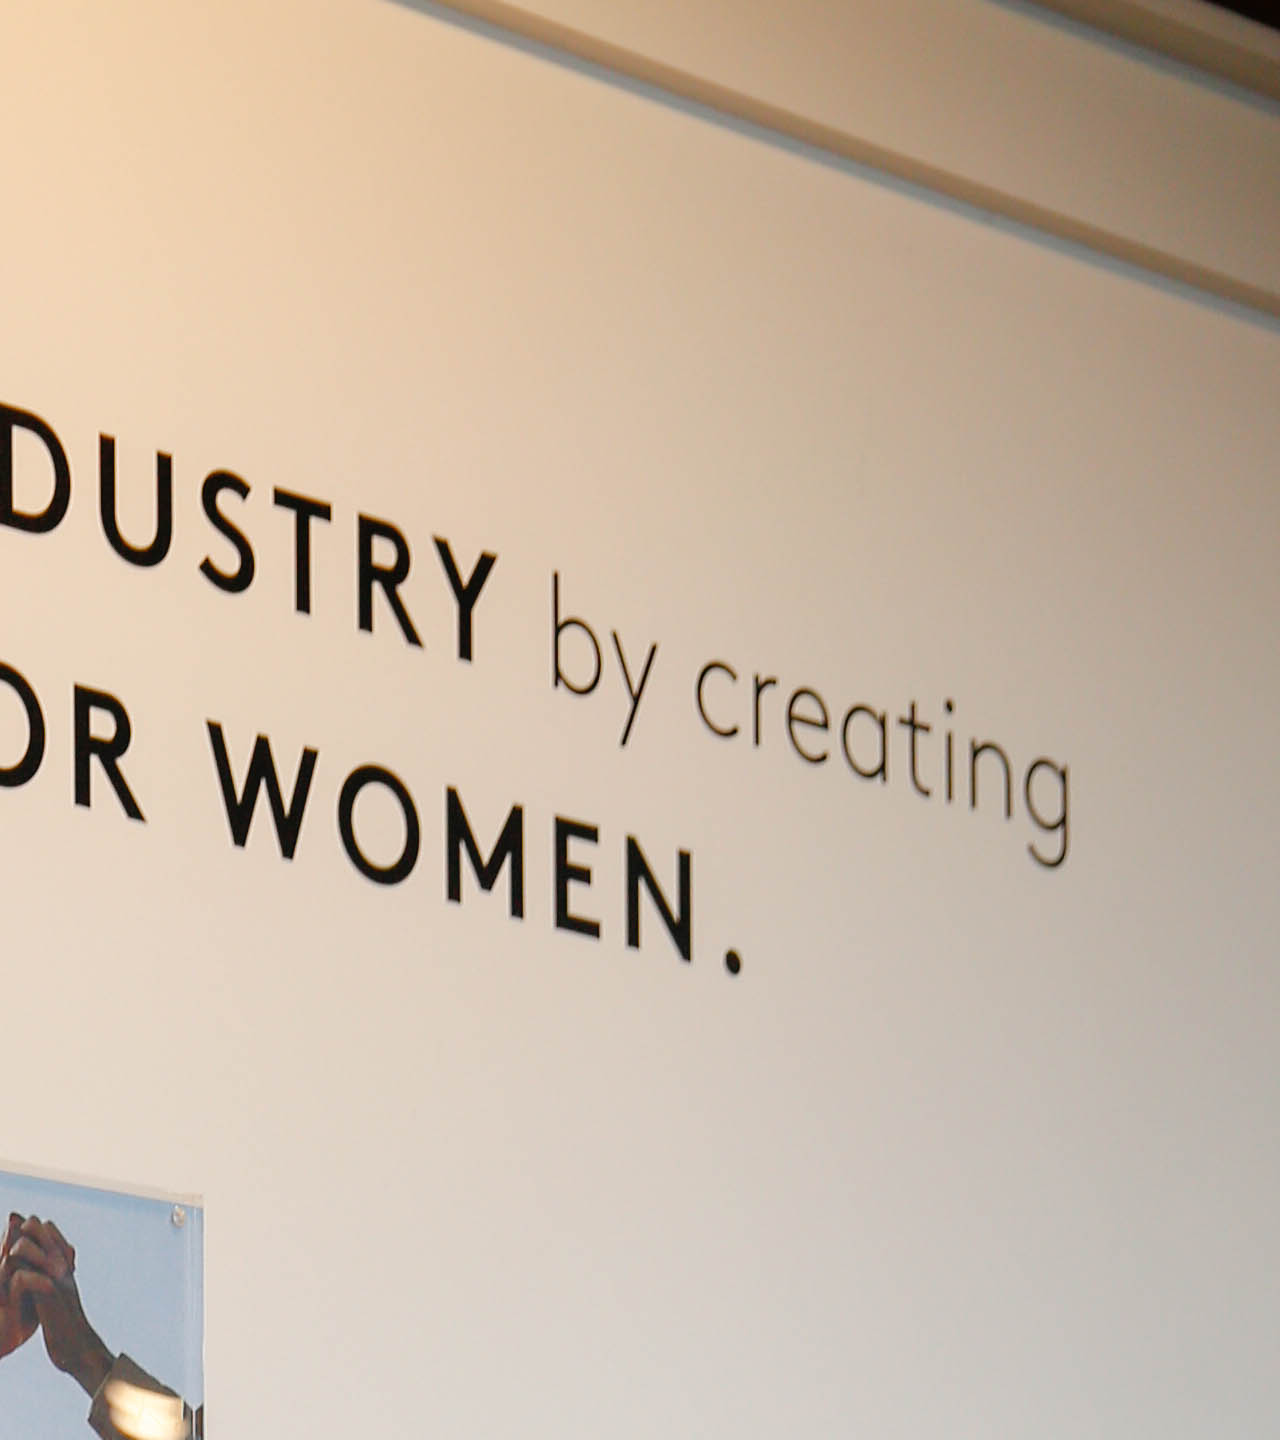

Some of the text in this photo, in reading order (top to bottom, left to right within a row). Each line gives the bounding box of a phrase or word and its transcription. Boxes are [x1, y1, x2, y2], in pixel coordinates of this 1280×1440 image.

[205, 719, 743, 978] WOMEN.
[551, 569, 659, 749] by
[695, 657, 1070, 872] creating
